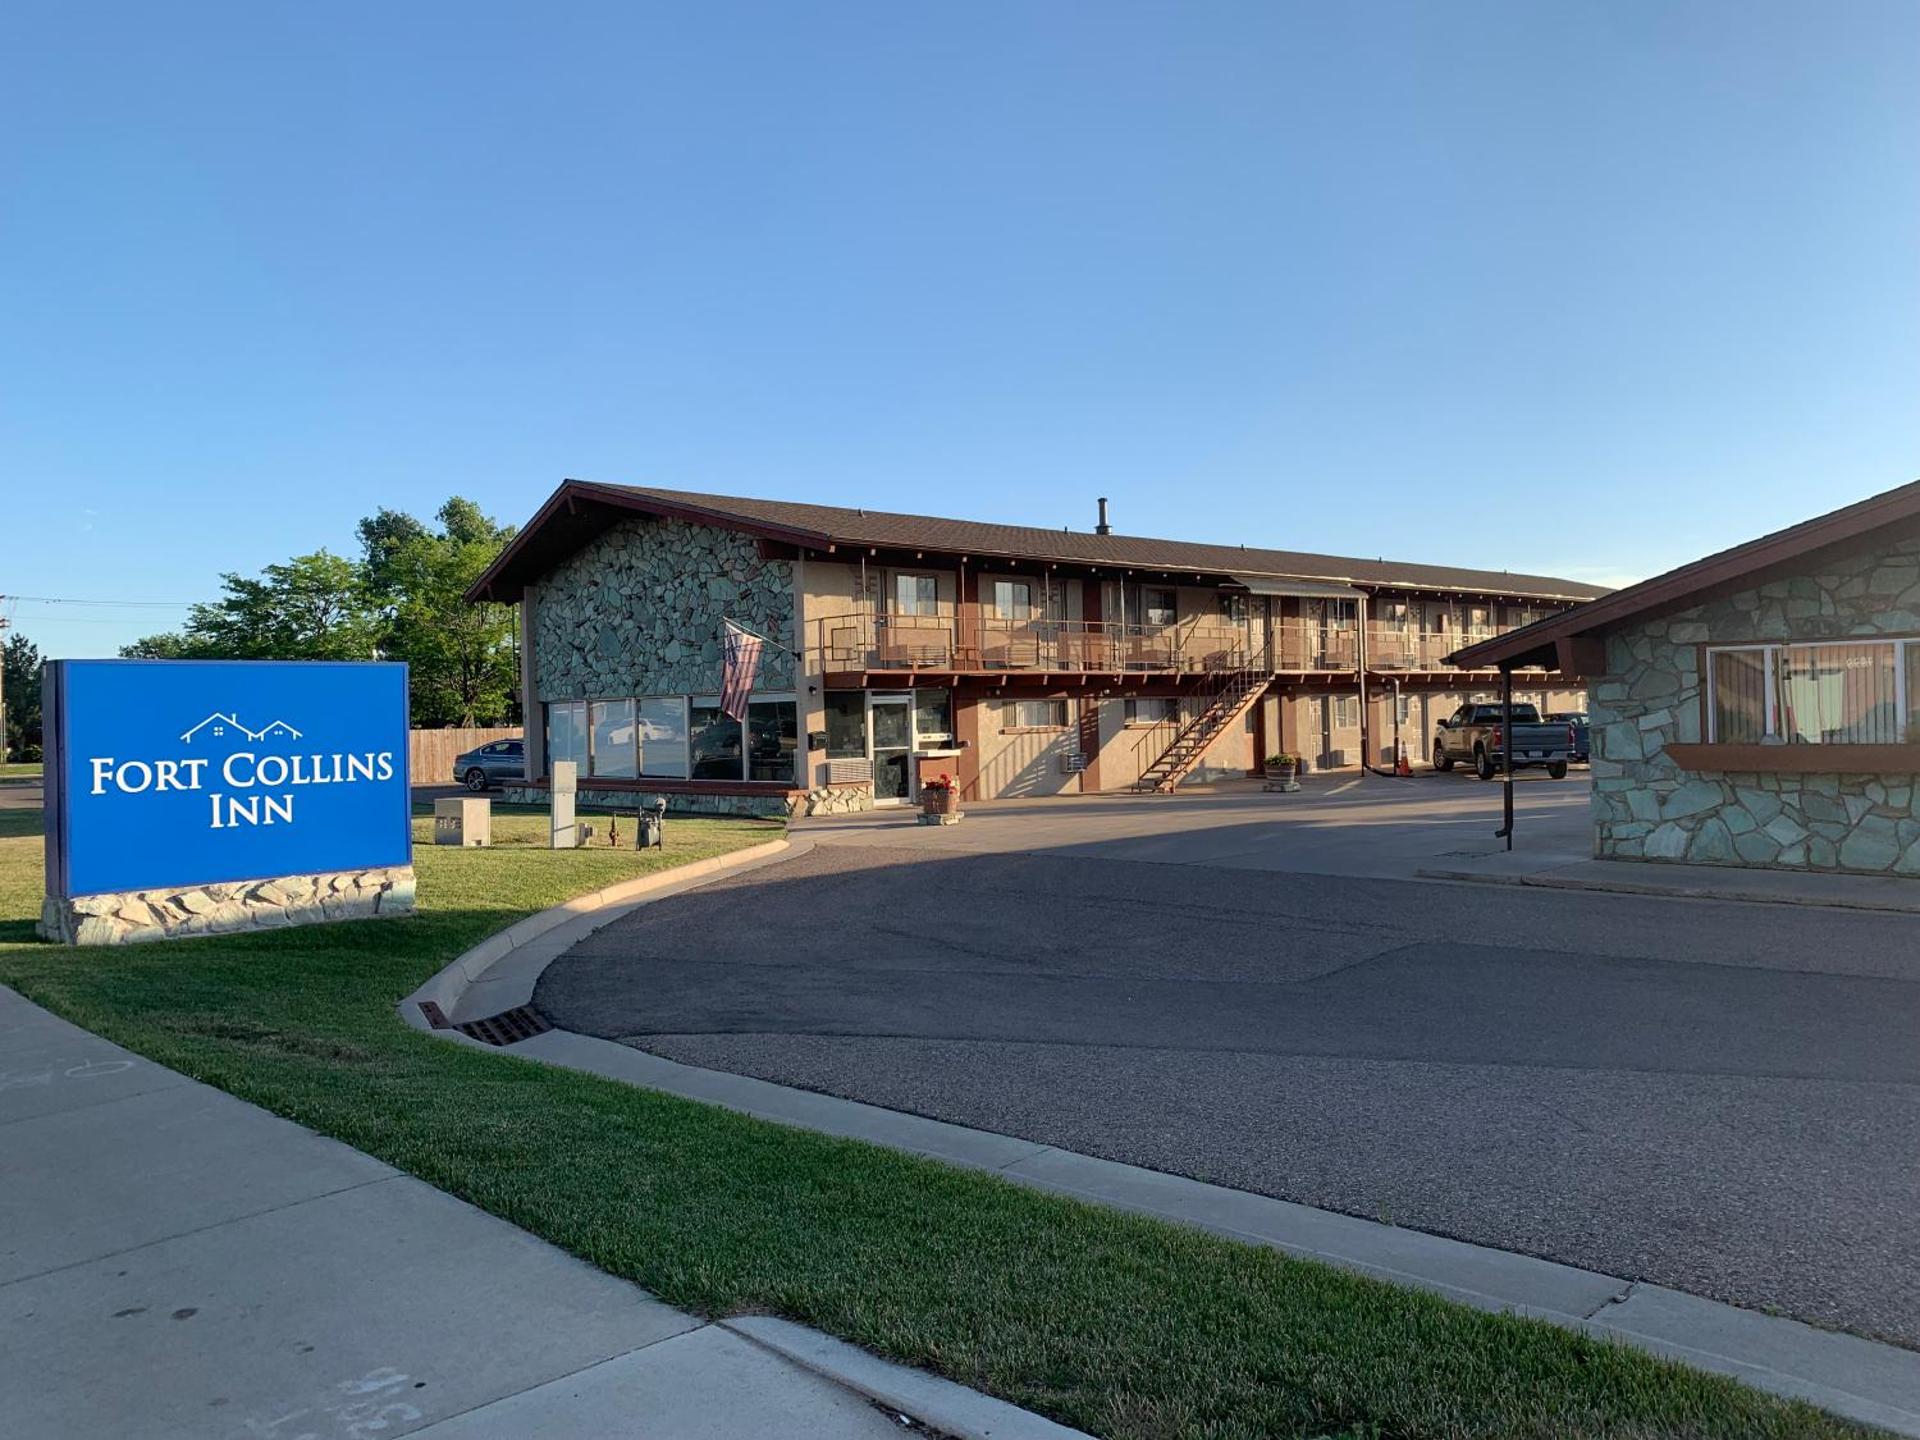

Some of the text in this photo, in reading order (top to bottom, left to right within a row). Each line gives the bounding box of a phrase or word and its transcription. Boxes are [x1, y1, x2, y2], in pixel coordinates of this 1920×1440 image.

[90, 752, 393, 795] FORT COLLINS
[209, 794, 294, 828] INN
